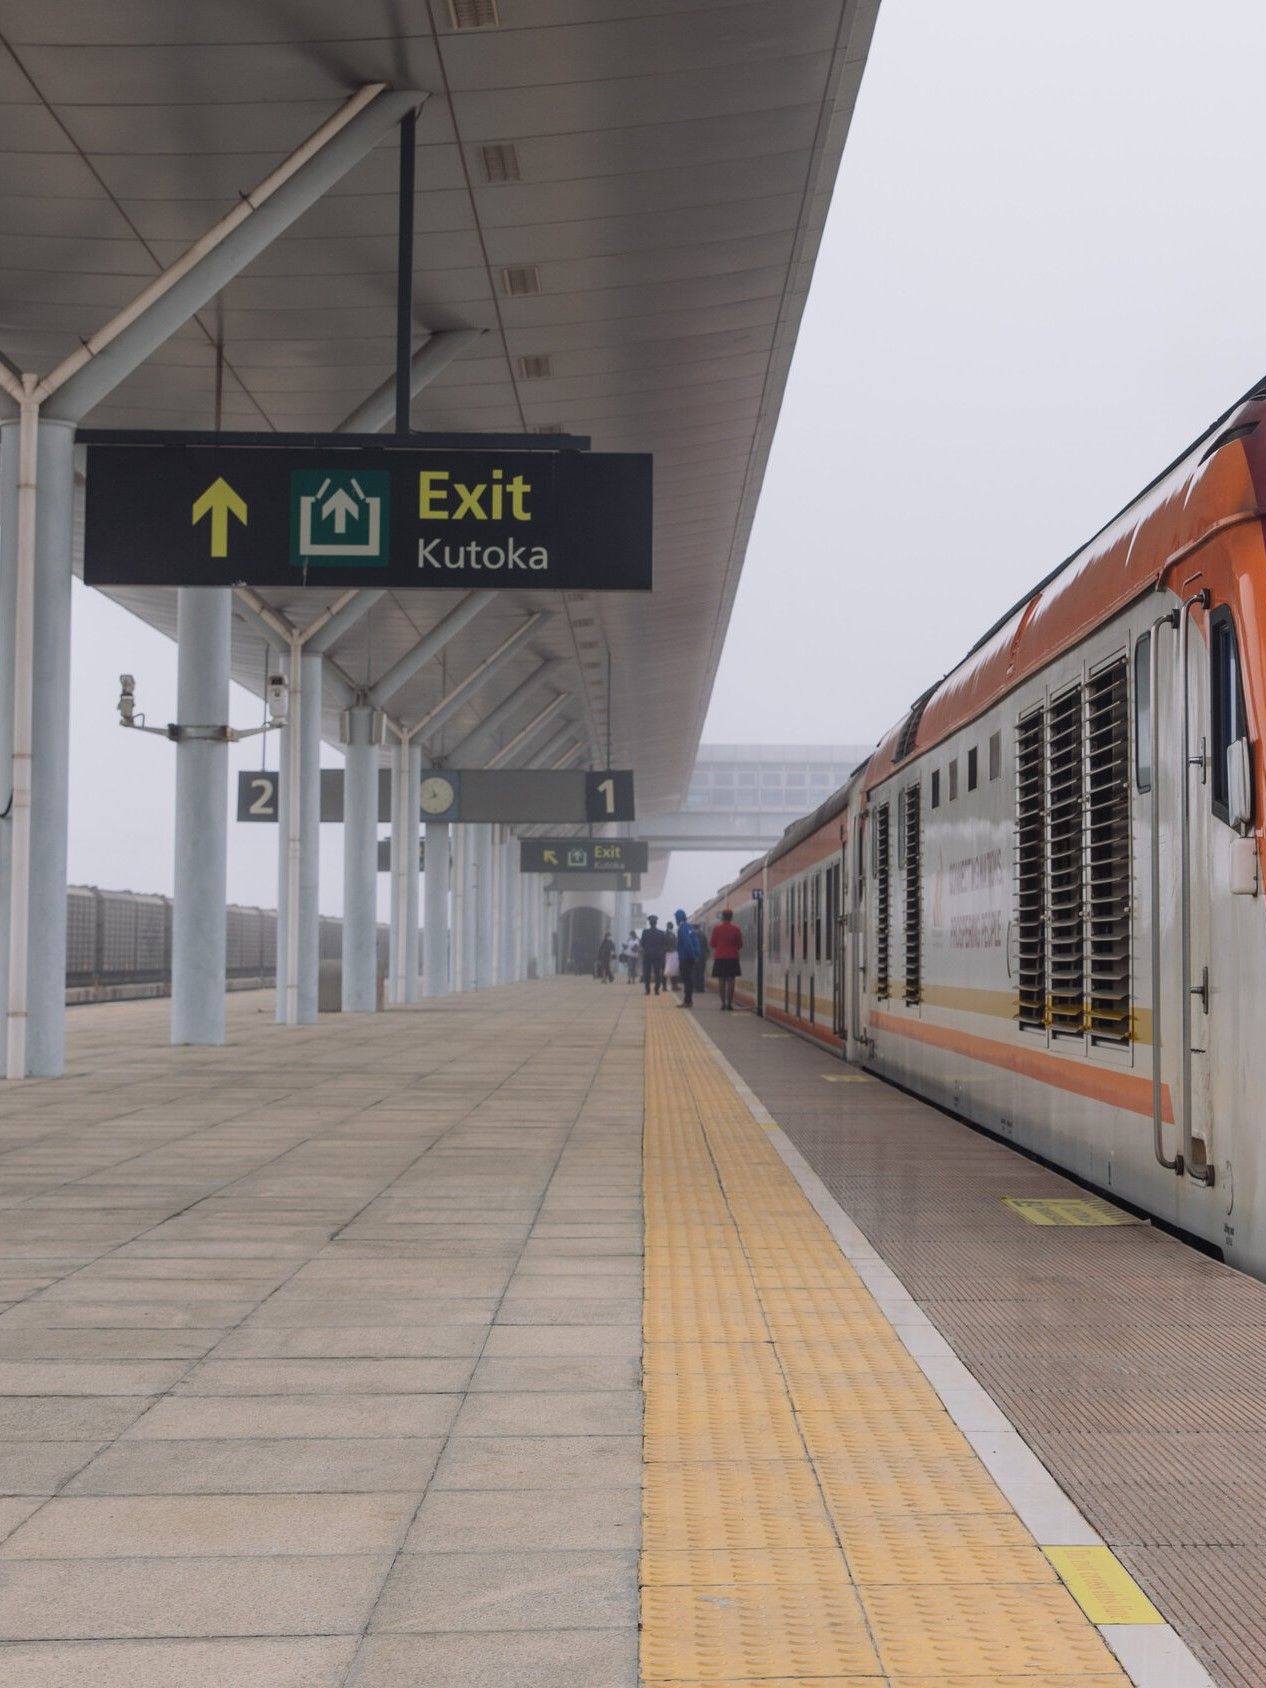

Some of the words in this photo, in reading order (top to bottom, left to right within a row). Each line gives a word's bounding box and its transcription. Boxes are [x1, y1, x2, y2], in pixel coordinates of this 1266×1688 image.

[418, 469, 532, 521] Exit
[417, 537, 549, 570] Kutoka
[249, 778, 274, 815] 2
[596, 779, 616, 814] 1
[594, 845, 621, 859] Exit
[623, 872, 632, 888] 1
